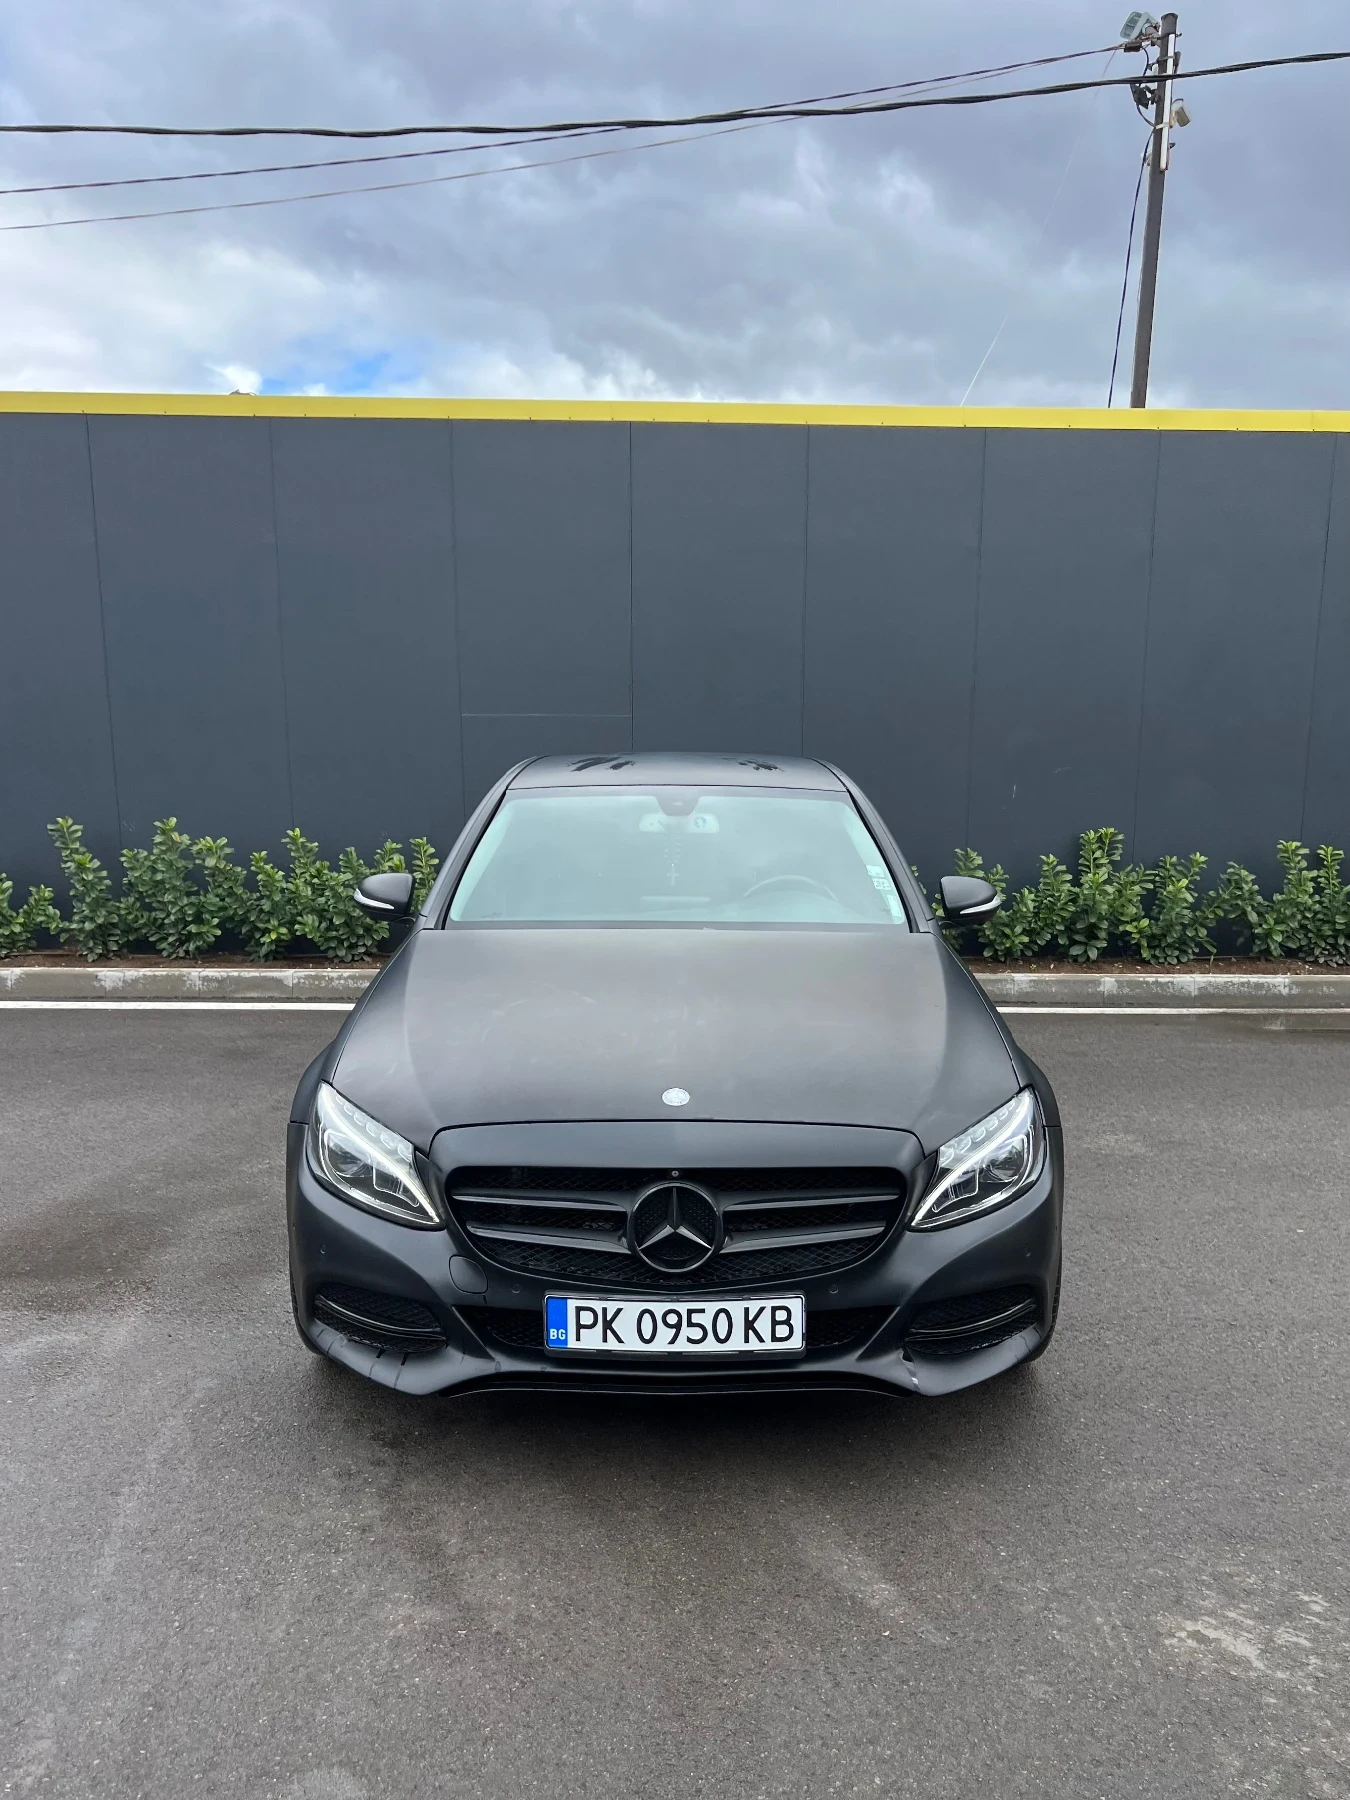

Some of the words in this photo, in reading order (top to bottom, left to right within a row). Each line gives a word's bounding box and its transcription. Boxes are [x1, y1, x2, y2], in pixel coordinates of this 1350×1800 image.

[550, 1329, 566, 1340] BG
[574, 1306, 625, 1344] PK
[636, 1308, 734, 1345] 0950
[743, 1306, 795, 1344] KB
